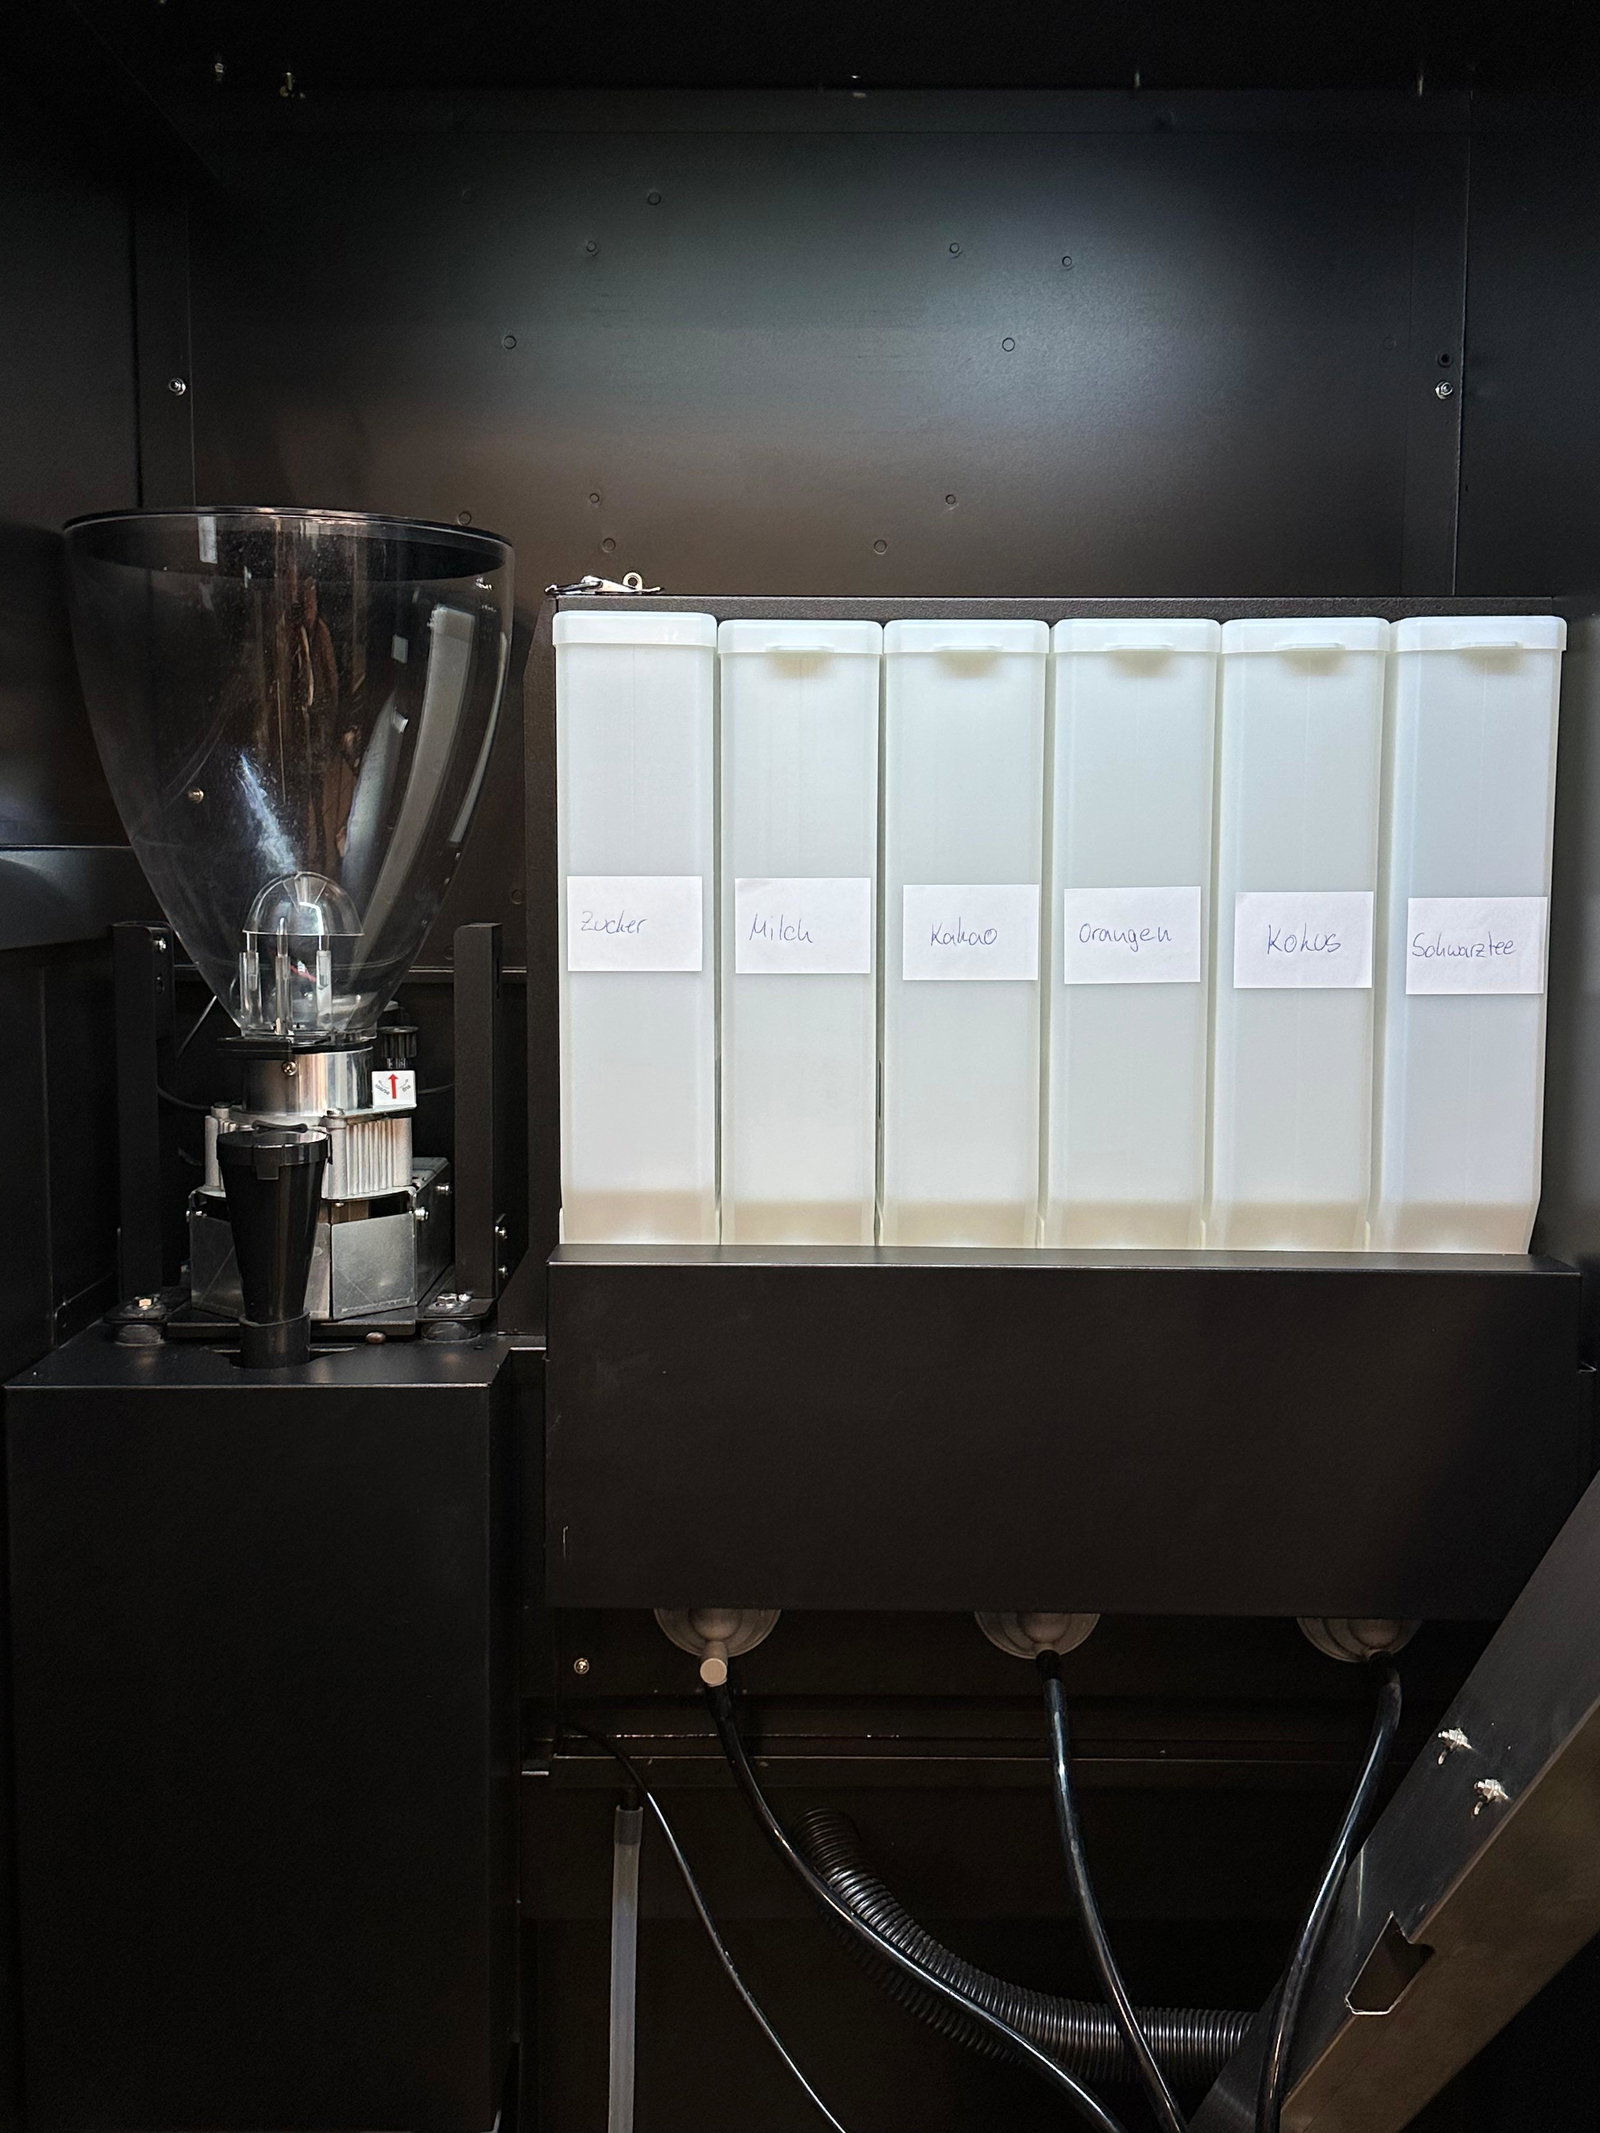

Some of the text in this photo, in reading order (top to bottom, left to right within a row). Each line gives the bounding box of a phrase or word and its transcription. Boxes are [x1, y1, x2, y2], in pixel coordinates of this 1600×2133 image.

[581, 910, 648, 935] Zucker
[748, 913, 814, 944] Milch
[930, 917, 999, 947] Kakao
[1078, 922, 1173, 952] Orangen
[1411, 931, 1518, 959] Schwarztee
